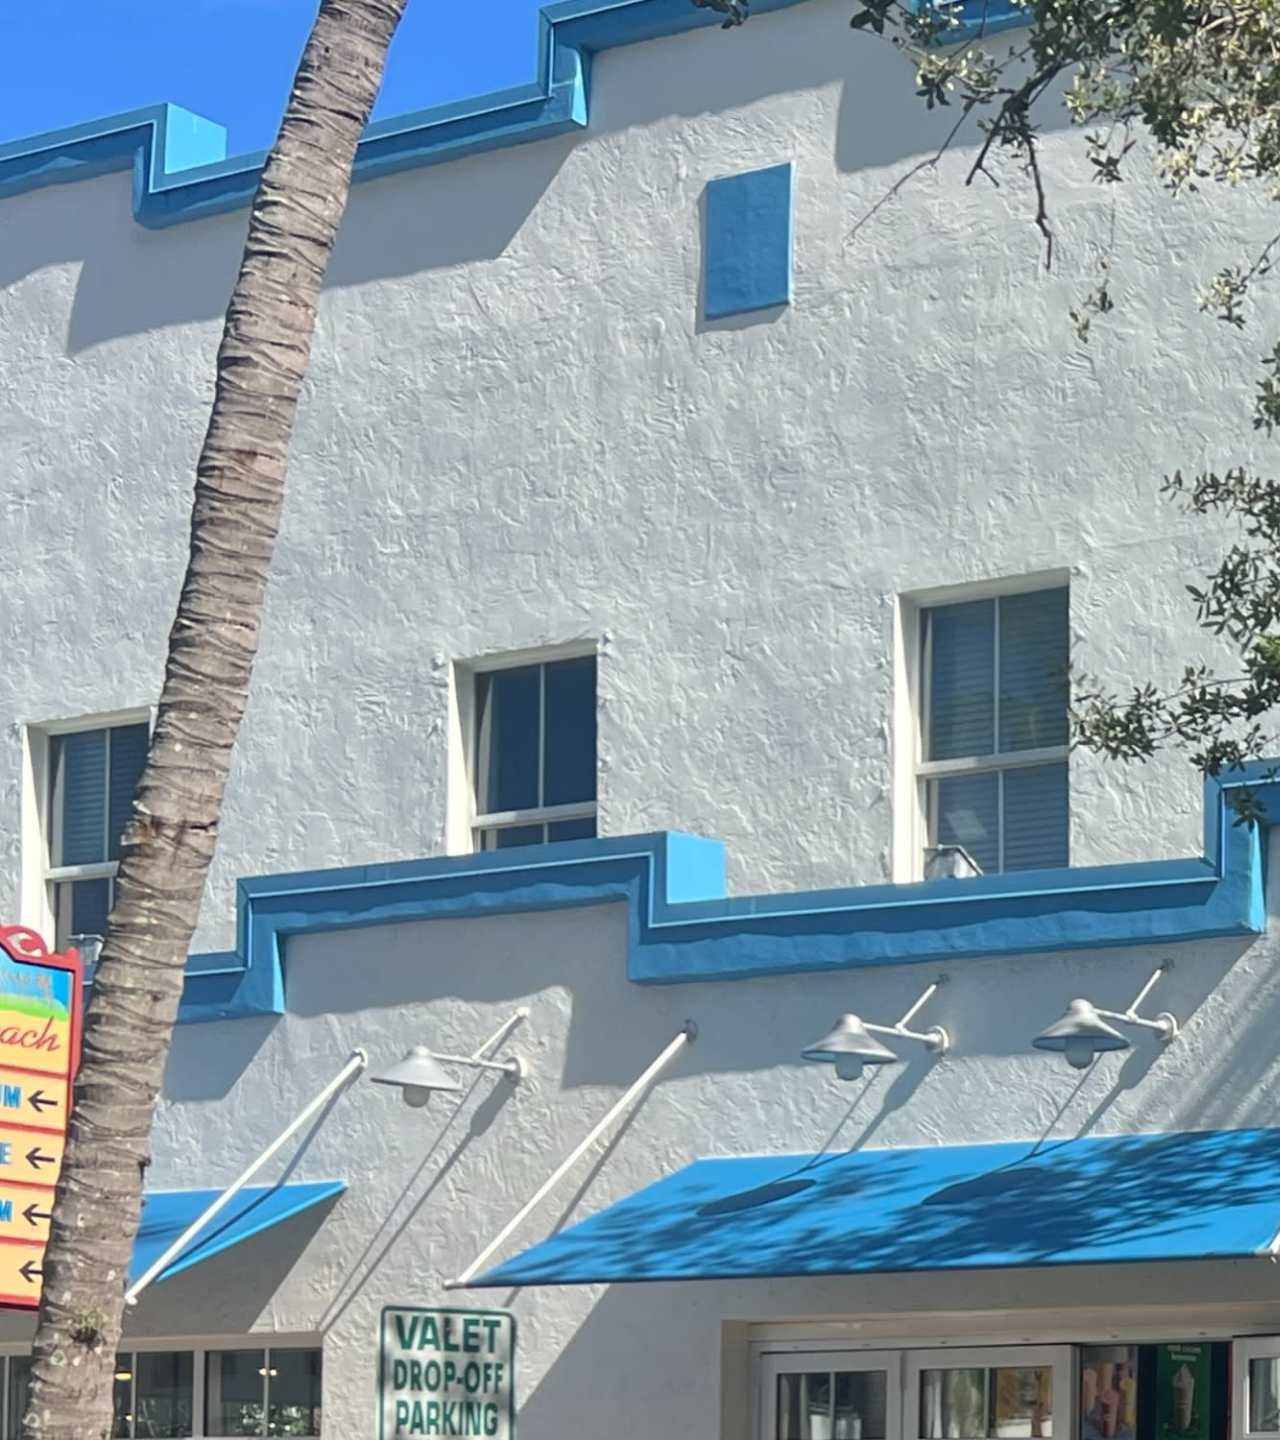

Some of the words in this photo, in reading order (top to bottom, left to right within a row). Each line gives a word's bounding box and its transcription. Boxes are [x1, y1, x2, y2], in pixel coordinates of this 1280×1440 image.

[395, 1315, 502, 1354] VALET
[393, 1359, 504, 1394] DROP-OFF
[395, 1400, 499, 1437] PARKING
